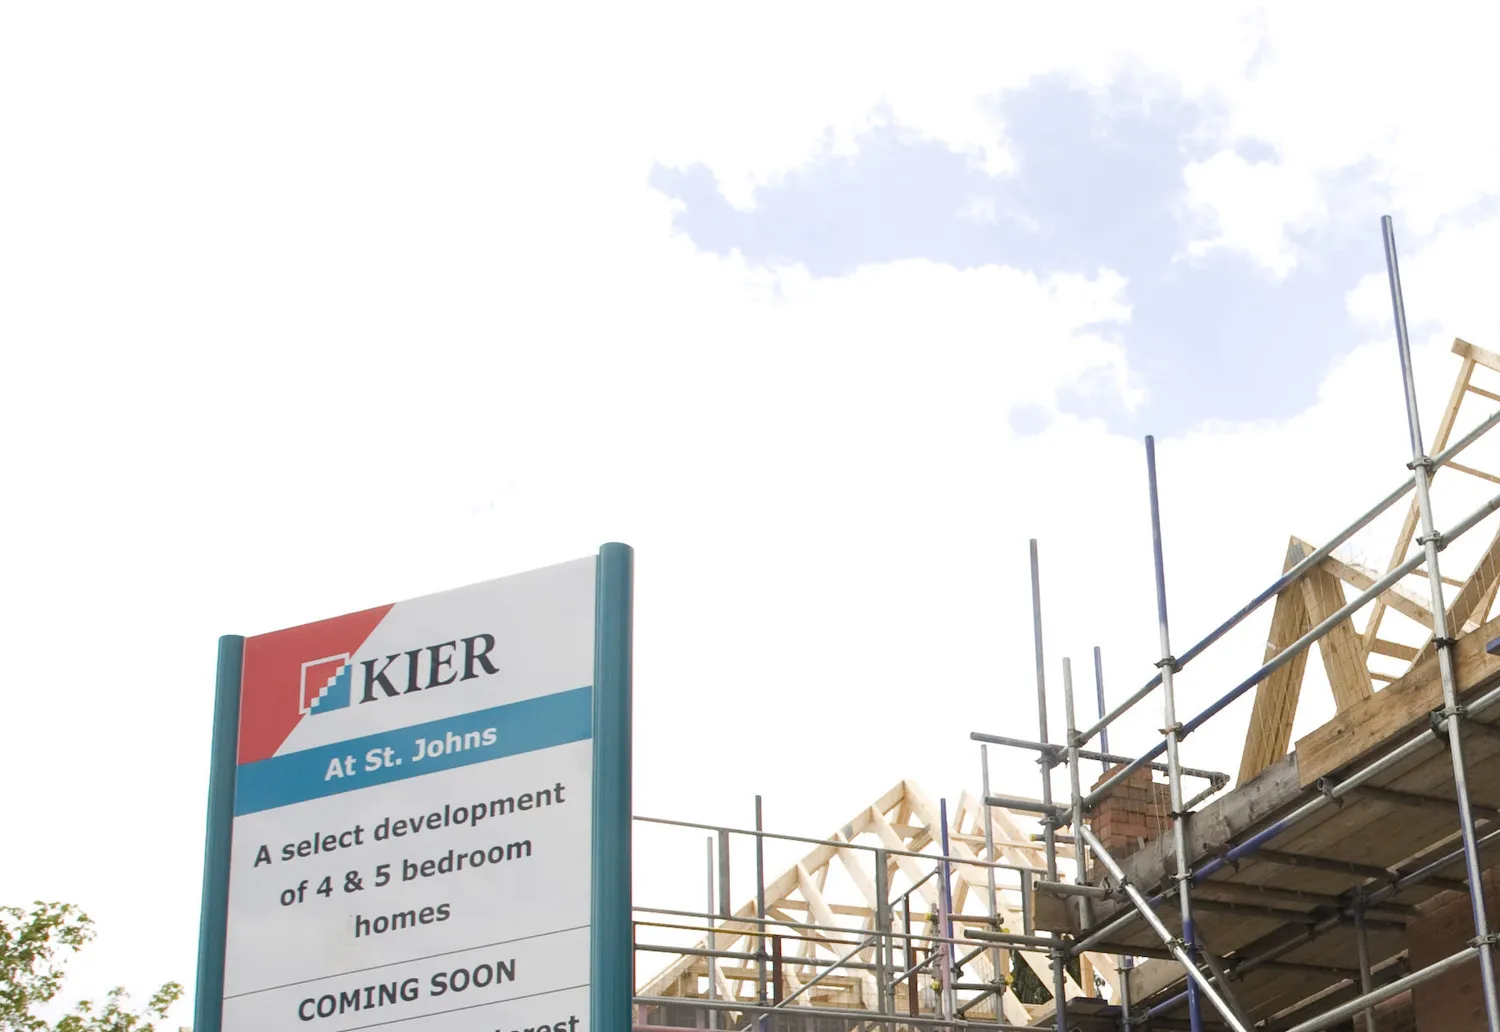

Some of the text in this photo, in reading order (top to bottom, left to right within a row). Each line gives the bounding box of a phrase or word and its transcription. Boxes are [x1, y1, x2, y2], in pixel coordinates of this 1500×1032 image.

[358, 633, 500, 704] KIER
[324, 727, 498, 781] At St. Johns
[253, 782, 566, 867] A select development
[280, 838, 532, 906] of 4 & 5 bedroom
[355, 903, 451, 937] homes
[298, 959, 516, 1022] COMING SOON
